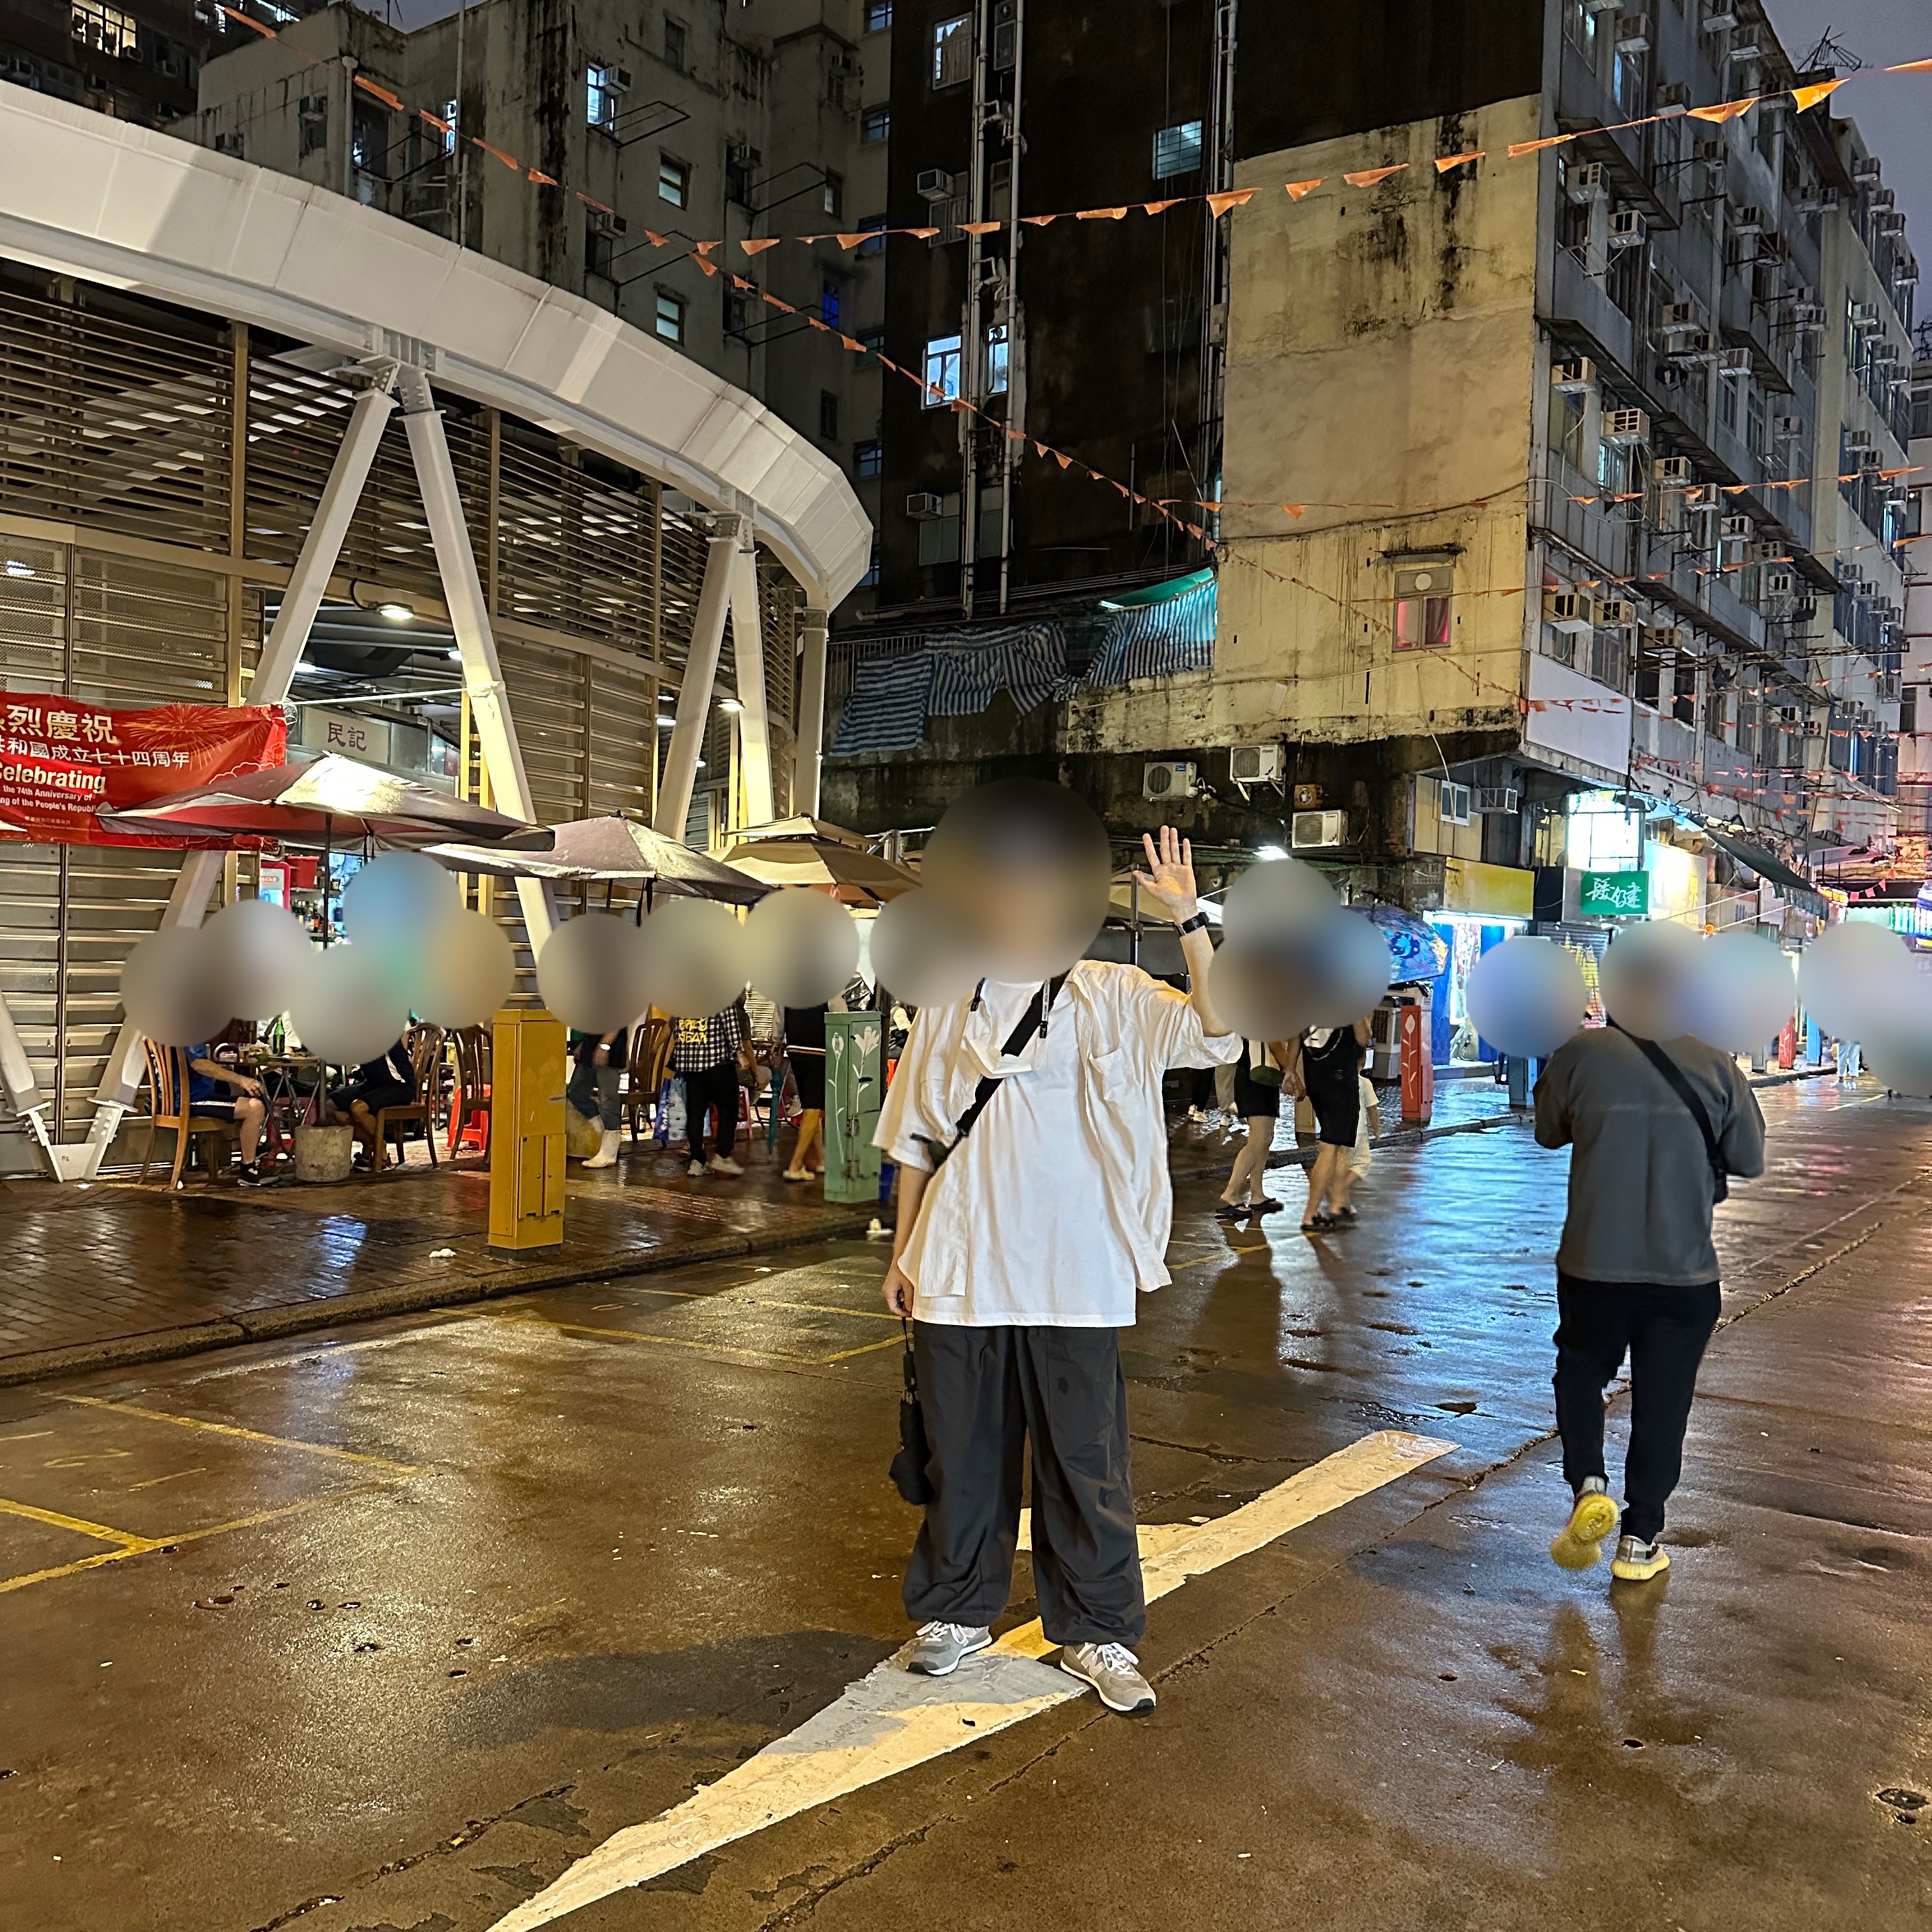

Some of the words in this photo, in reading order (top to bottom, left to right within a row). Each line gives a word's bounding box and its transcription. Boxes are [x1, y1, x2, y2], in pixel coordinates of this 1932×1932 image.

[0, 705, 119, 744] 烈慶祝
[328, 721, 367, 751] 民記
[0, 762, 106, 794] elebrating
[0, 797, 10, 806] ng
[22, 798, 34, 807] the
[3, 785, 15, 793] the
[17, 786, 33, 796] 74th
[35, 788, 82, 802] Anniversary
